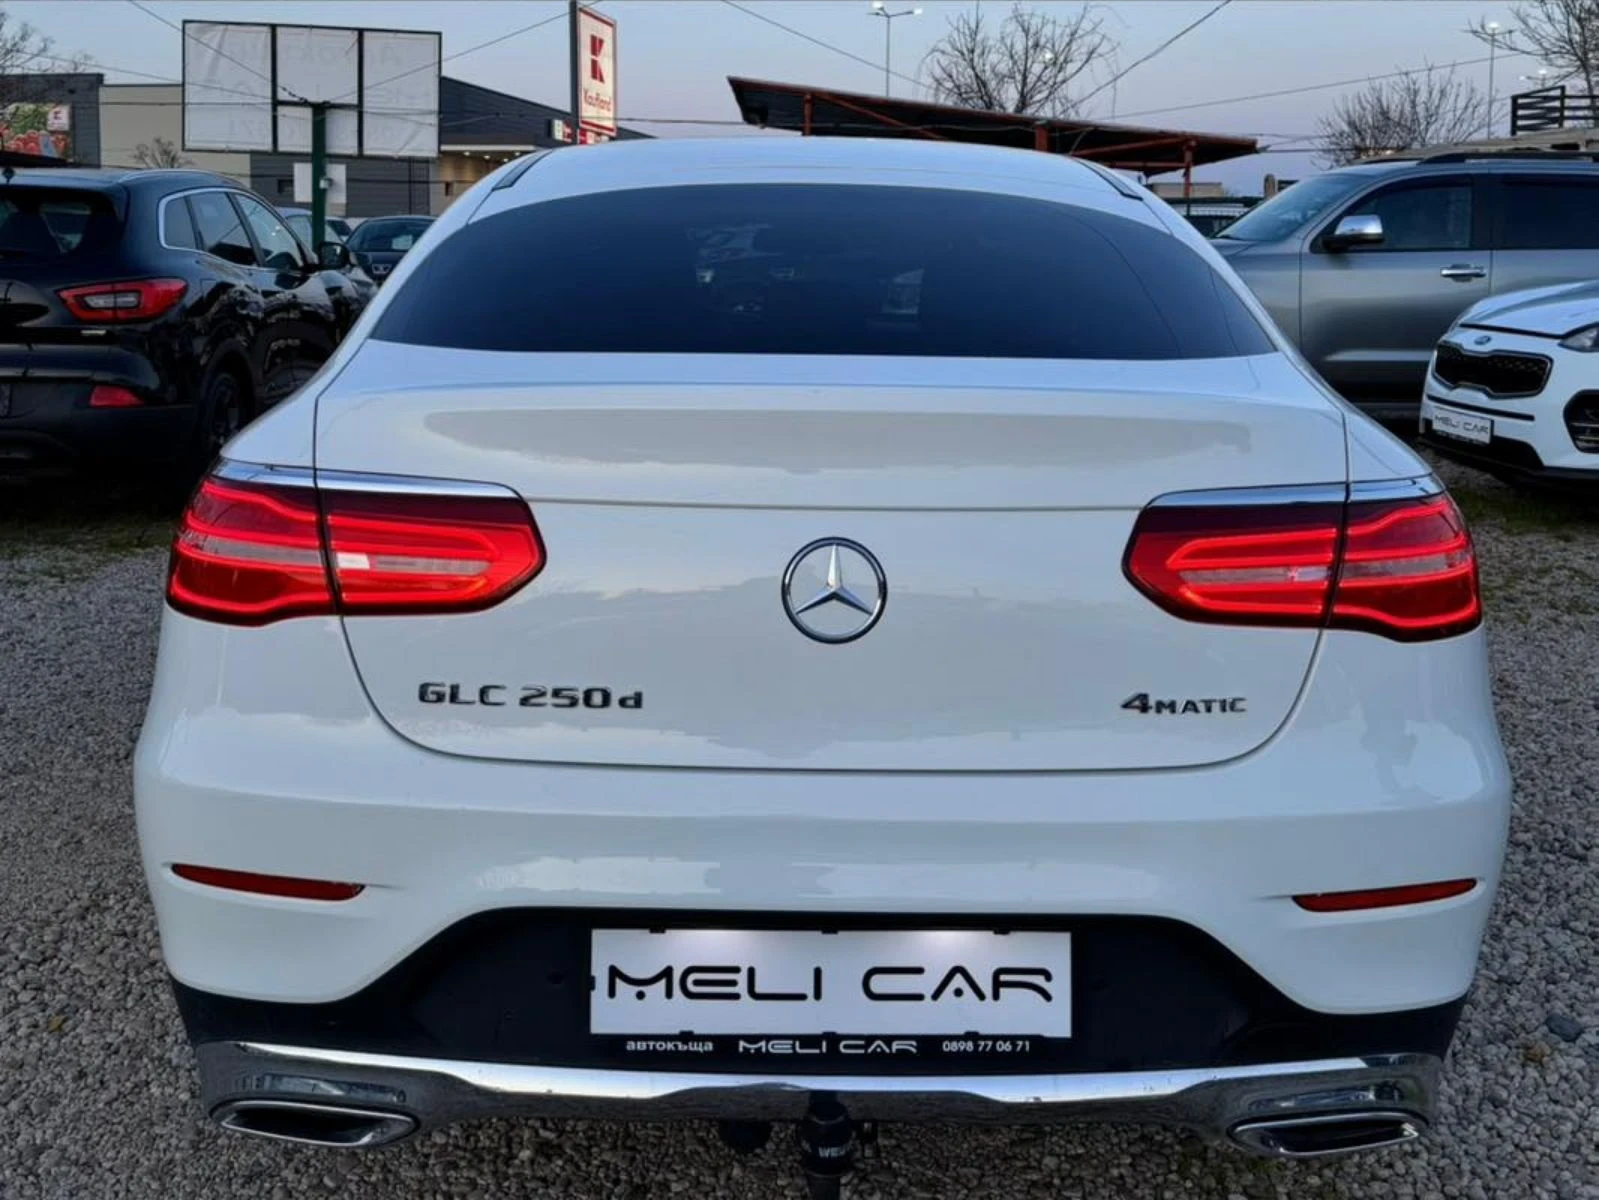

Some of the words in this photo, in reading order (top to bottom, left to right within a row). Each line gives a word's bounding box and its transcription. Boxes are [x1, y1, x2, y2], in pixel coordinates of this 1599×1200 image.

[418, 682, 507, 706] GLC
[1120, 693, 1247, 714] 4MATIC
[607, 964, 823, 1002] MELI
[862, 965, 1053, 1003] CAR
[626, 1041, 713, 1054] автокъща
[738, 1040, 827, 1054] MELI
[839, 1040, 917, 1054] CAR
[942, 1040, 974, 1052] 0898
[978, 1040, 994, 1051] 77
[996, 1040, 1012, 1052] 06
[1016, 1040, 1030, 1051] 71
